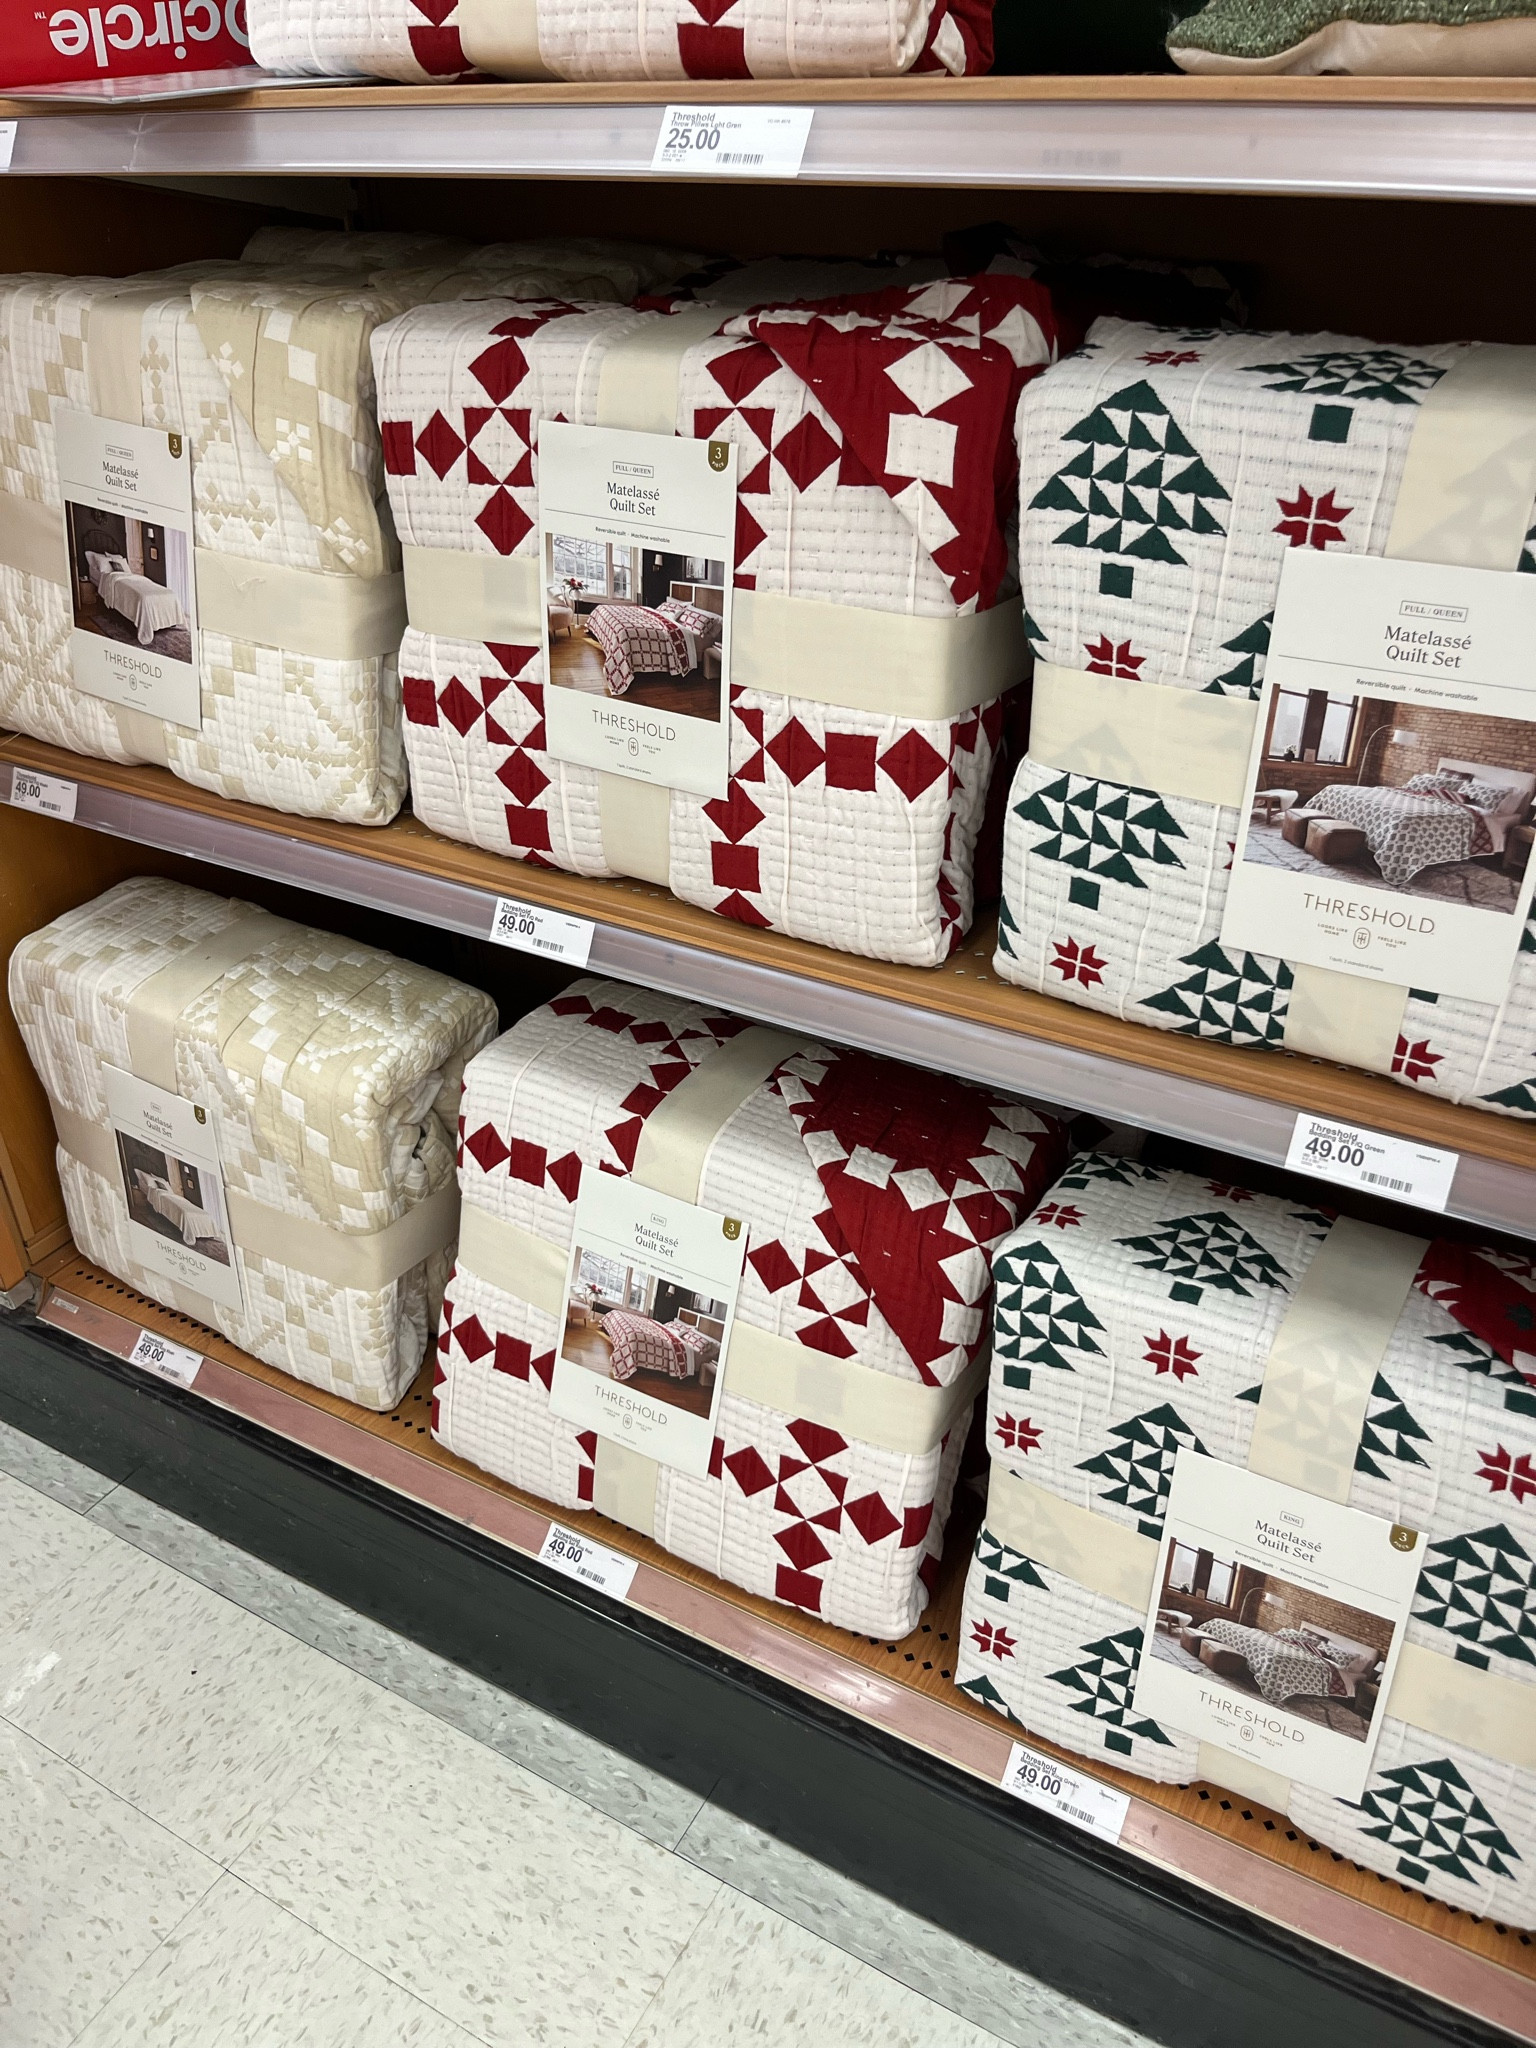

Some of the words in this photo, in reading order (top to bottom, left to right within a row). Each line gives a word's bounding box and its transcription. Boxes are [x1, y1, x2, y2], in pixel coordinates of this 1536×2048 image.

[672, 112, 716, 122] Threshold
[665, 128, 721, 150] 25.00
[172, 438, 178, 449] 3
[714, 447, 722, 460] 3
[103, 461, 139, 479] Matelassé
[615, 464, 629, 472] FULL
[632, 466, 651, 475] QUEEN
[105, 474, 123, 488] Quilt
[125, 479, 137, 491] Set
[607, 482, 660, 501] Matelassé
[609, 498, 635, 513] Quilt
[638, 502, 656, 516] Set
[1404, 604, 1426, 615] FULL
[1433, 607, 1463, 618] QUEEN
[1384, 625, 1472, 650] Matelassé
[103, 649, 162, 679] THRESHOLD
[1386, 645, 1429, 664] Quilt
[1432, 651, 1462, 668] Set
[1356, 678, 1390, 689] Reversible
[1391, 684, 1407, 693] quilt
[1414, 687, 1444, 698] Machine
[1444, 691, 1479, 702] washable
[591, 709, 676, 741] THRESHOLD
[15, 781, 41, 798] 49.00
[502, 902, 532, 914] Threshold
[1303, 892, 1436, 934] THRESHOLD
[499, 914, 535, 936] 49.00
[146, 1120, 162, 1134] Quilt
[162, 1127, 173, 1139] Set
[1311, 1122, 1359, 1142] Threshold
[1305, 1137, 1365, 1167] 49.00
[1308, 1129, 1336, 1143] Bedding
[1337, 1137, 1350, 1146] Set
[1364, 1142, 1386, 1155] Green
[634, 1223, 679, 1248] Matelassé
[728, 1222, 735, 1232] 3
[155, 1240, 207, 1271] THRESHOLD
[635, 1235, 657, 1251] Quilt
[658, 1244, 674, 1258] Set
[138, 1342, 165, 1362] 49.00
[594, 1384, 668, 1425] THRESHOLD
[1283, 1514, 1301, 1526] KING
[554, 1527, 581, 1544] Threshold
[1255, 1519, 1322, 1553] Matelassé
[1398, 1531, 1407, 1542] 3
[548, 1538, 583, 1563] 49.00
[1256, 1534, 1290, 1555] Quilt
[1292, 1547, 1315, 1564] Set
[1199, 1690, 1305, 1743] THRESHOLD
[1022, 1751, 1058, 1773] Threshold
[1017, 1764, 1061, 1796] 49.00
[1063, 1777, 1080, 1789] Green
